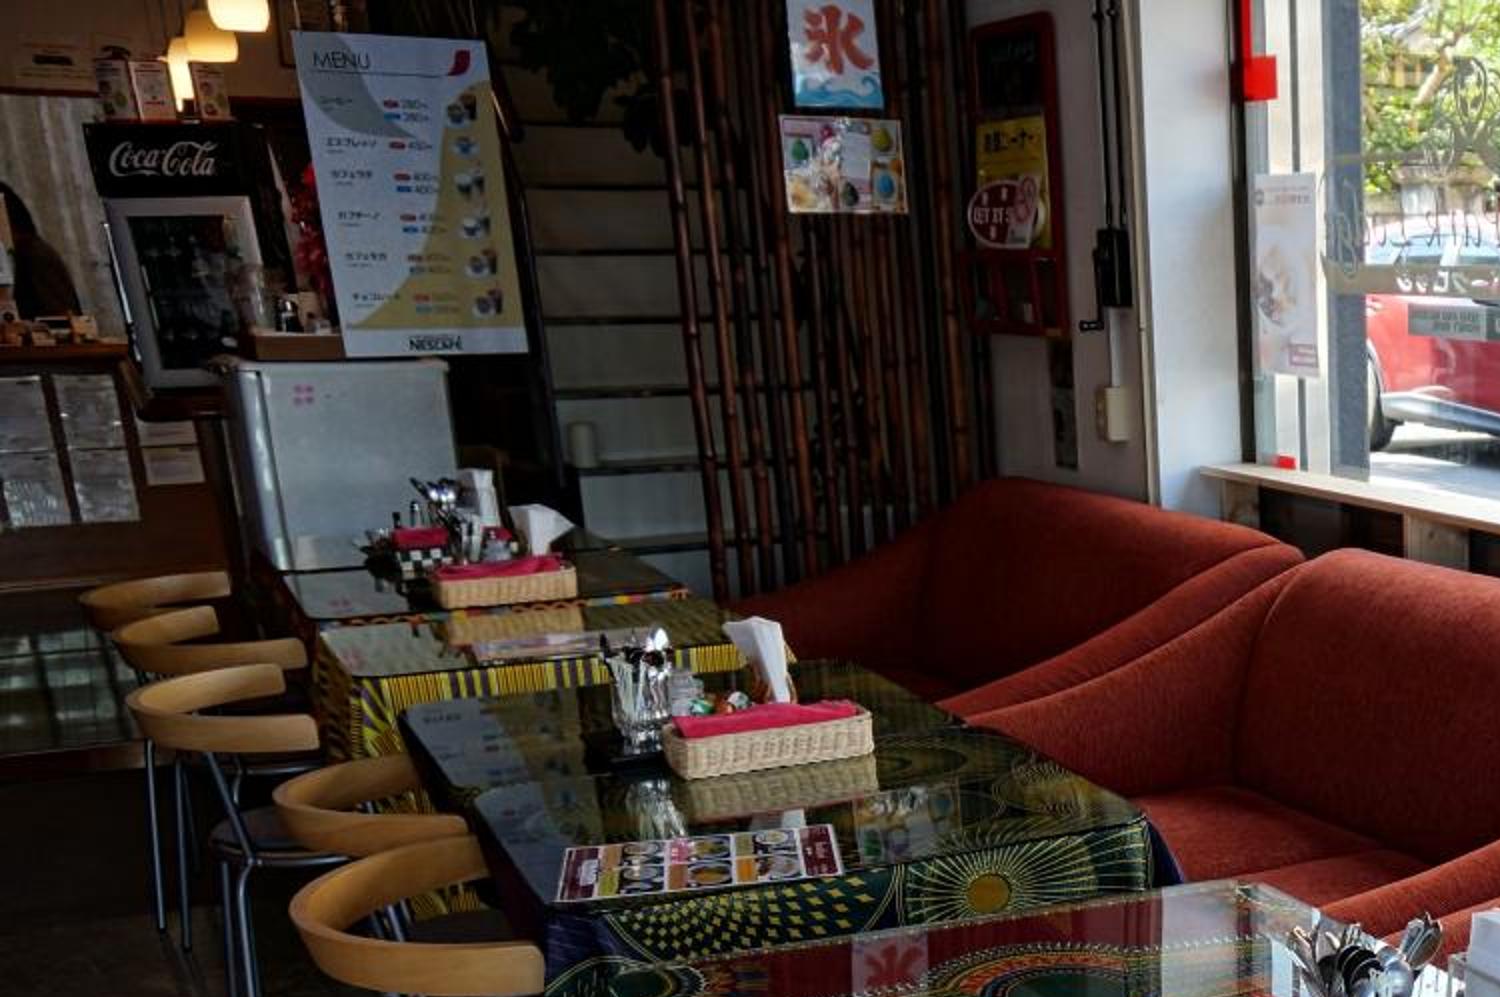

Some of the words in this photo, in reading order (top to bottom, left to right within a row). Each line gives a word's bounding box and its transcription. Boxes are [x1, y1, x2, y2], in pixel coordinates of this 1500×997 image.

[802, 4, 875, 75] 氷
[312, 51, 371, 71] MENU
[108, 140, 218, 178] Coca-Cola
